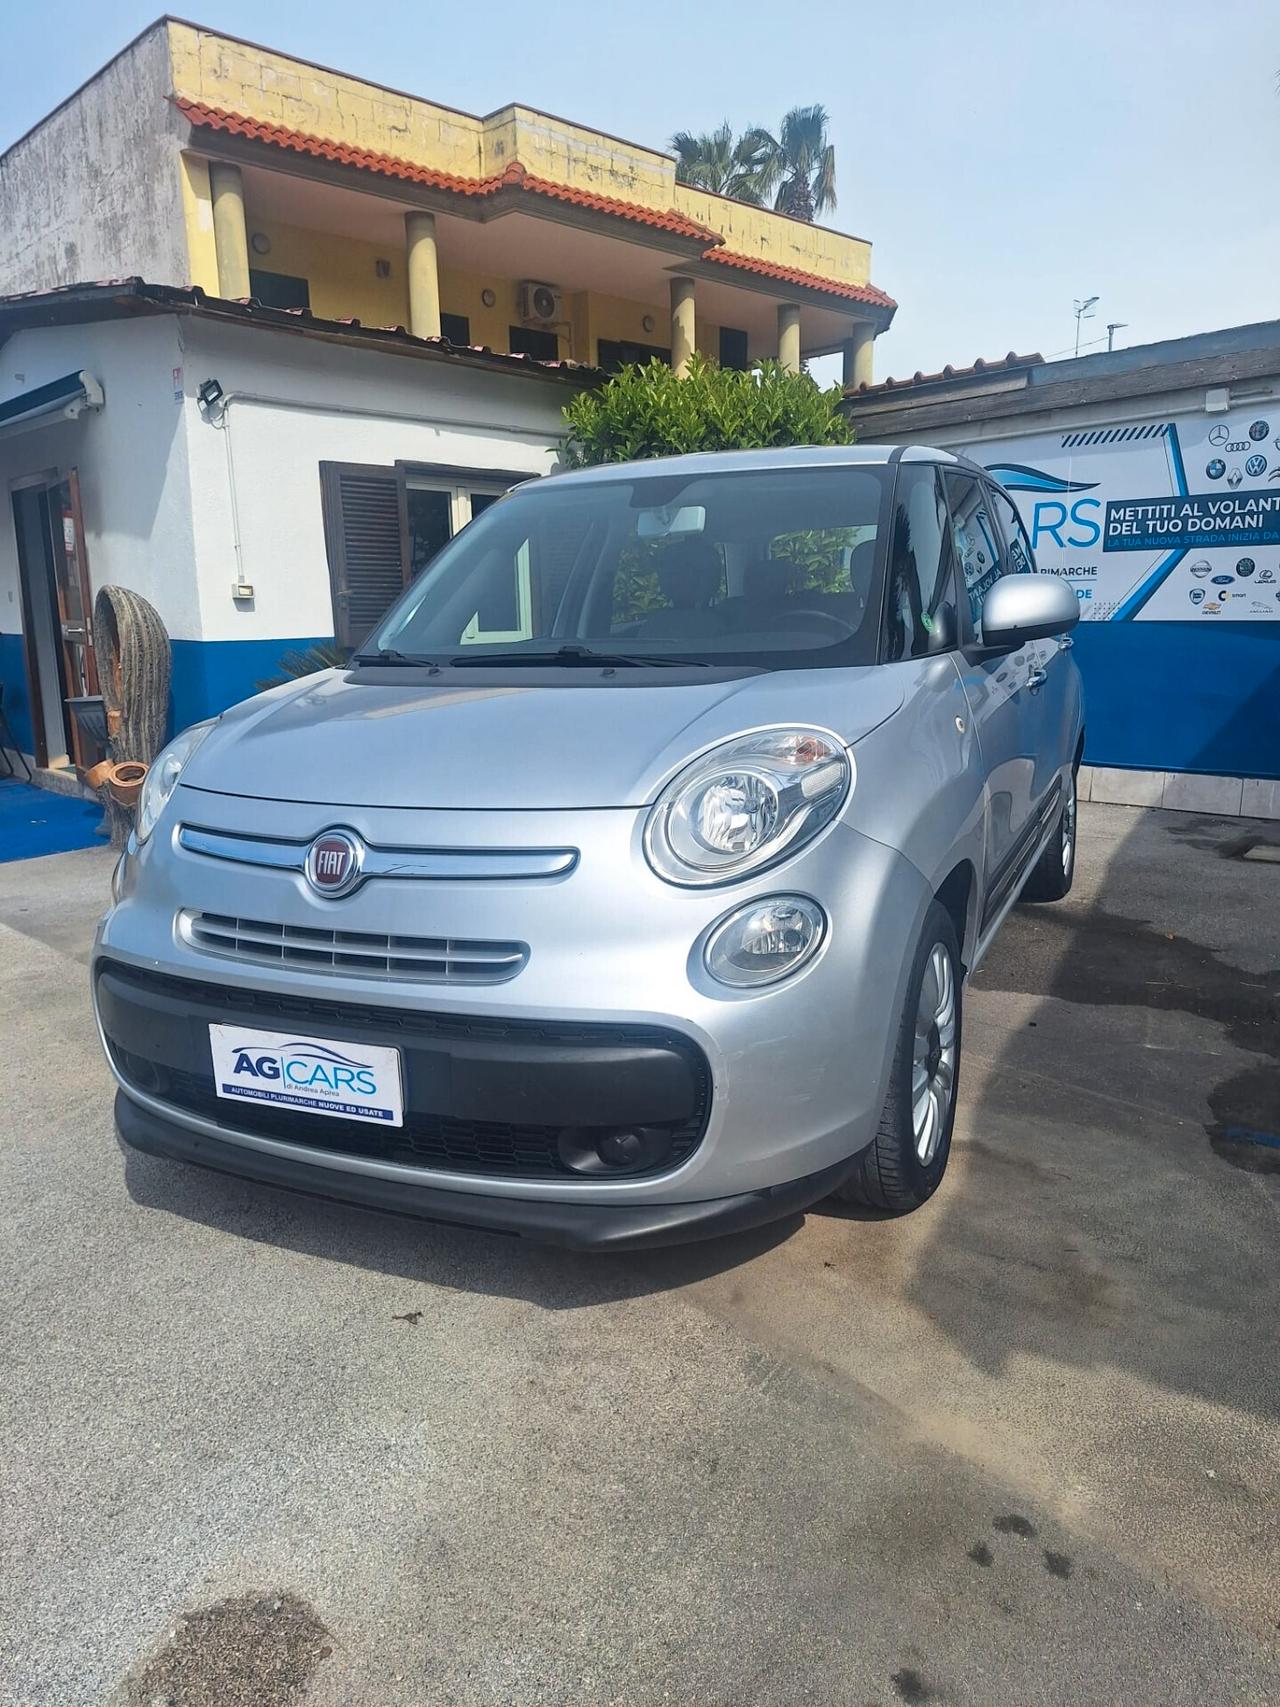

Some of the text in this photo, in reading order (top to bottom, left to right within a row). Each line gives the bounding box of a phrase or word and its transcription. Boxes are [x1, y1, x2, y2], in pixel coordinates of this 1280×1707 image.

[1110, 504, 1175, 521] METTITI
[1180, 503, 1203, 518] AL
[1109, 514, 1263, 536] DEL TUO DOMANI
[1107, 538, 1119, 547] LA
[1123, 538, 1141, 547] TUA
[1145, 535, 1180, 546] NUOVA
[1184, 533, 1226, 544] STRADA
[1227, 531, 1260, 542] INIZIA
[317, 850, 346, 875] FIAT
[233, 1053, 377, 1095] AG CARS
[294, 1085, 318, 1093] Andrea
[320, 1088, 340, 1096] Aprea
[231, 1087, 269, 1099] AUTOMOBILI
[270, 1094, 317, 1107] PLURIMARCHE
[318, 1102, 344, 1111] NUOVE
[358, 1107, 384, 1117] USATE
